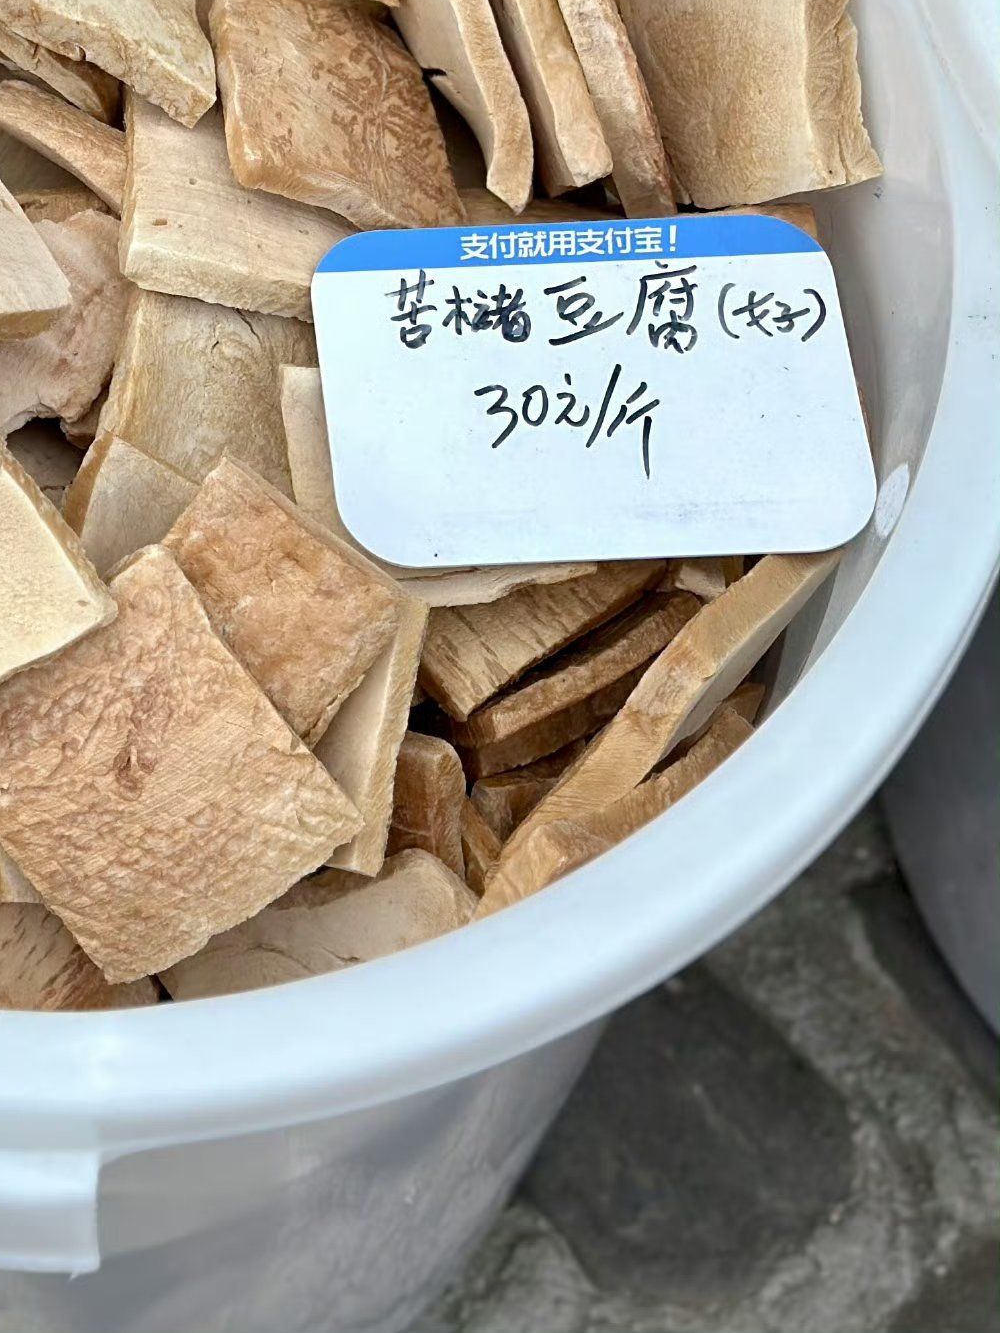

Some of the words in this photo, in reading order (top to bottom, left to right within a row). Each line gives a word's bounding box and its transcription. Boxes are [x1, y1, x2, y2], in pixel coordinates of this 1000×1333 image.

[461, 226, 677, 260] 支付就用支付宝!
[474, 364, 660, 480] 30元/斤
